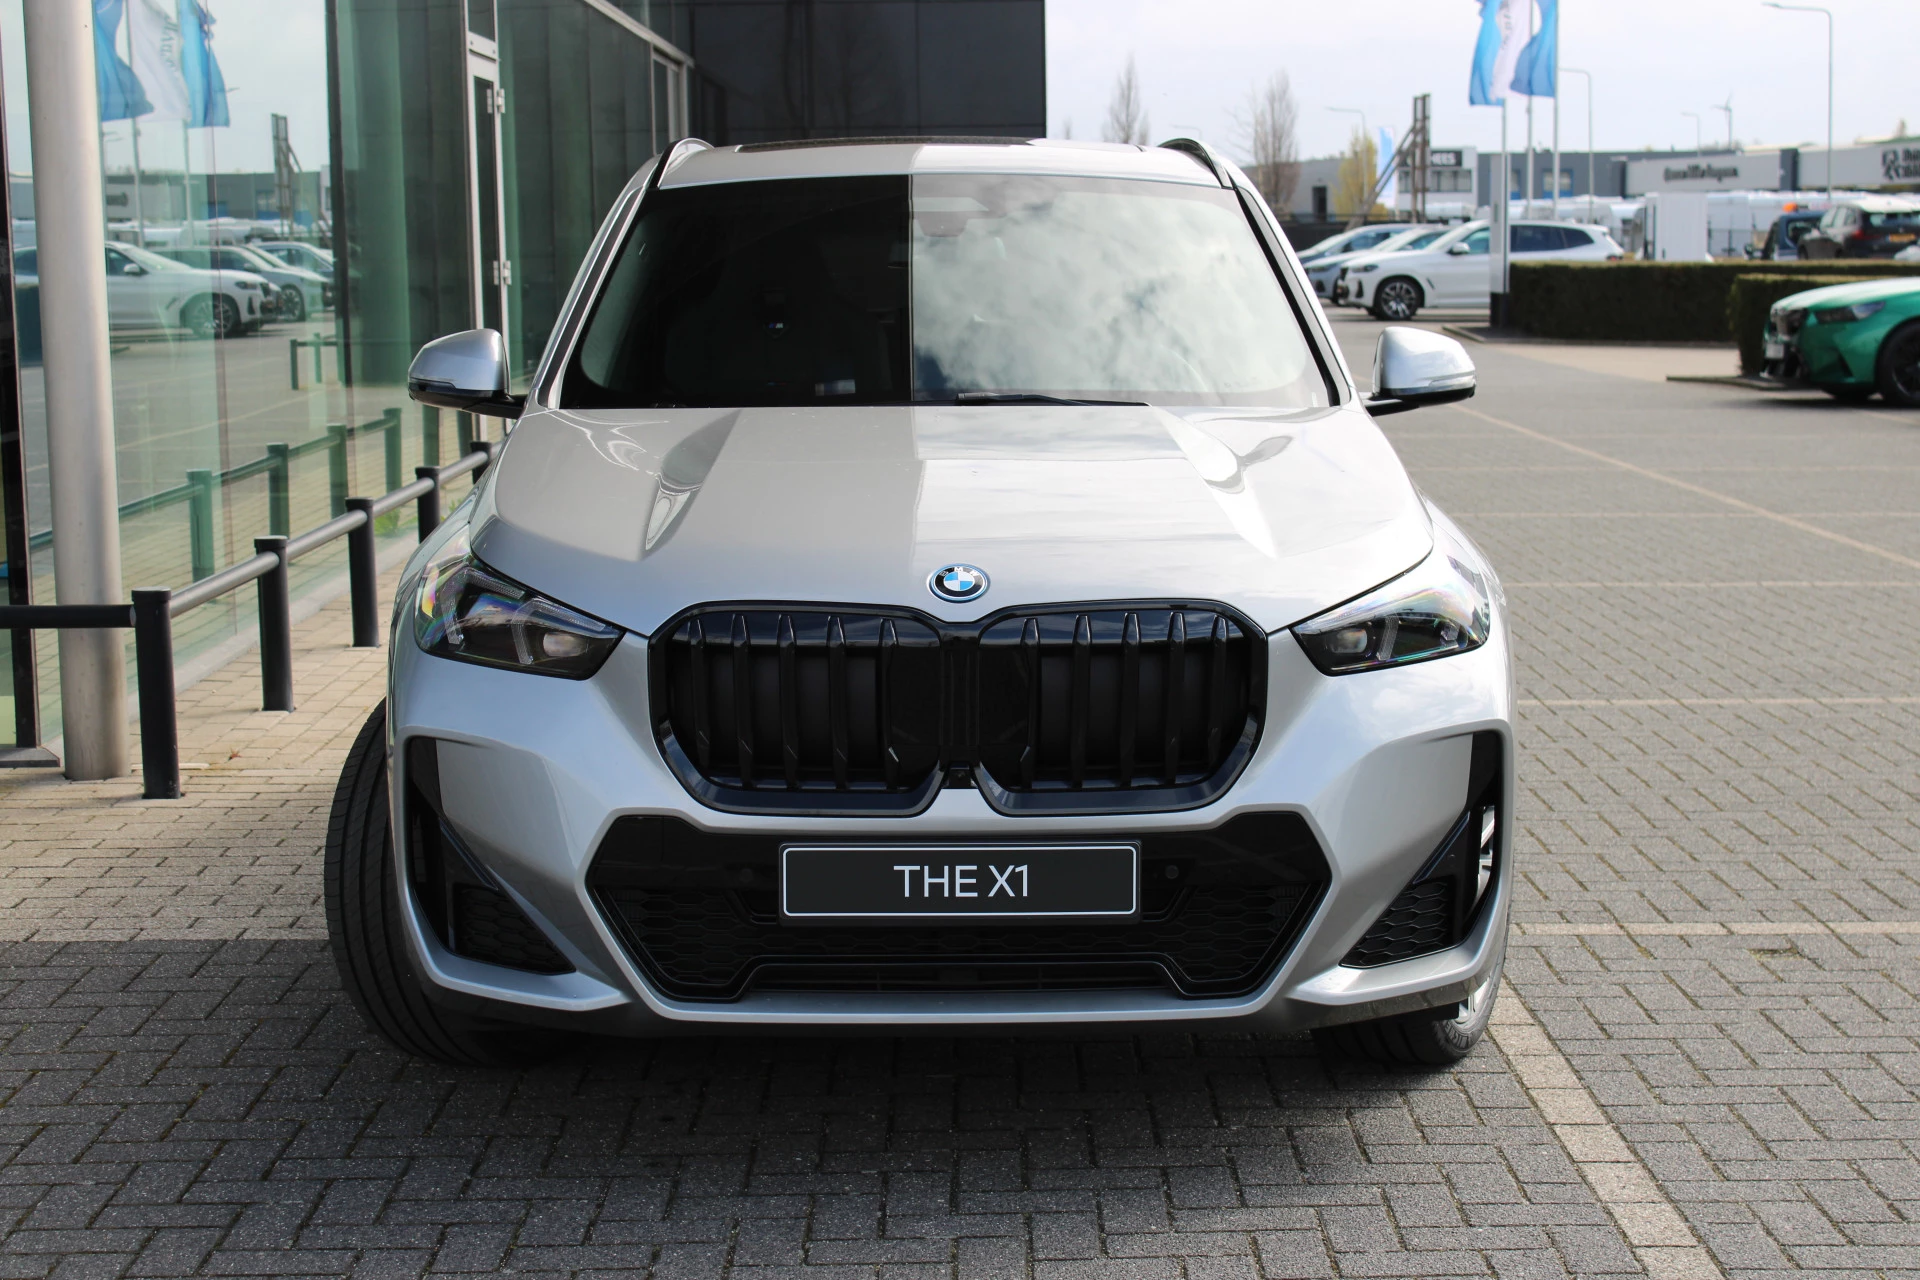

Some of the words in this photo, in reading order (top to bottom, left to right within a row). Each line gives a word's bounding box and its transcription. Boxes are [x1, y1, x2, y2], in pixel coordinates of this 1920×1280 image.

[938, 566, 981, 577] BMW
[893, 865, 979, 898] THE
[987, 864, 1028, 898] X1
